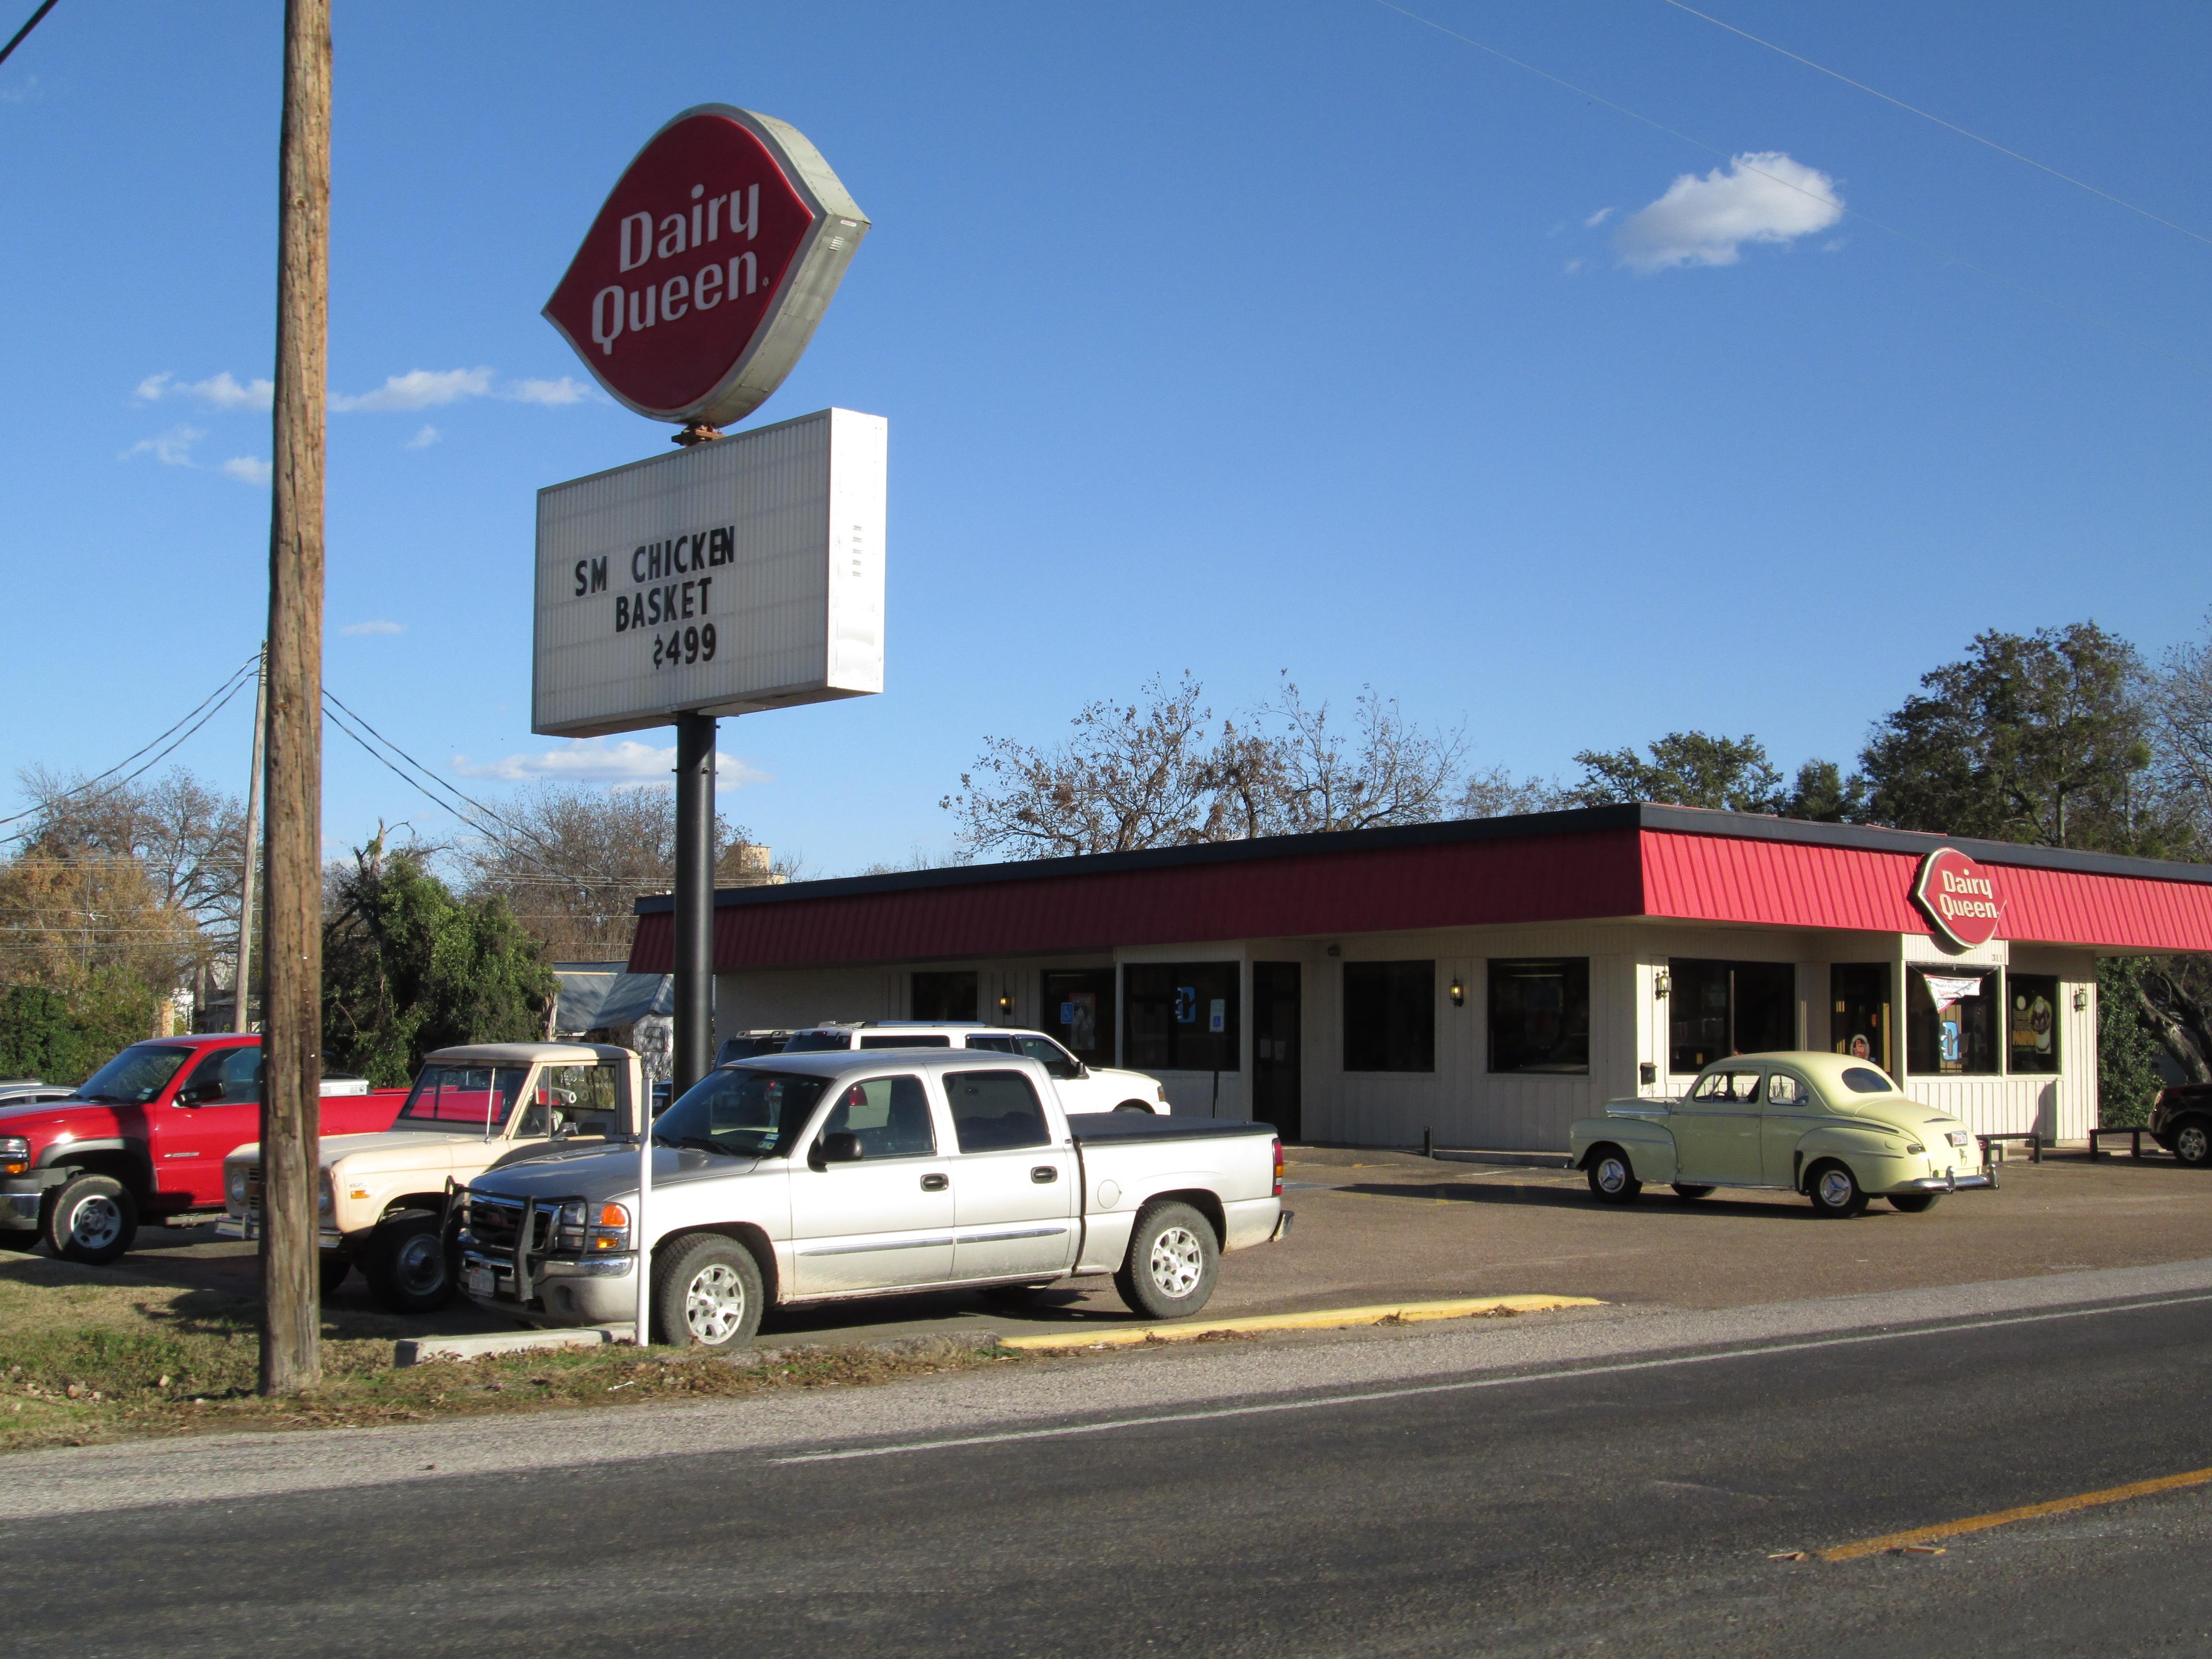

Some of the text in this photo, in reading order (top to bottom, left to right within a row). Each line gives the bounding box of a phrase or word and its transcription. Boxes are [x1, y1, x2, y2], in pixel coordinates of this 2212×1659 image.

[620, 183, 759, 273] Dairy
[592, 251, 757, 355] Queen
[576, 525, 735, 597] SM CHICKEN
[616, 577, 712, 633] BASKET
[653, 623, 716, 670] $499
[1939, 893, 1997, 921] Queen
[1941, 868, 1993, 900] Dairy
[1992, 954, 2003, 962] 311
